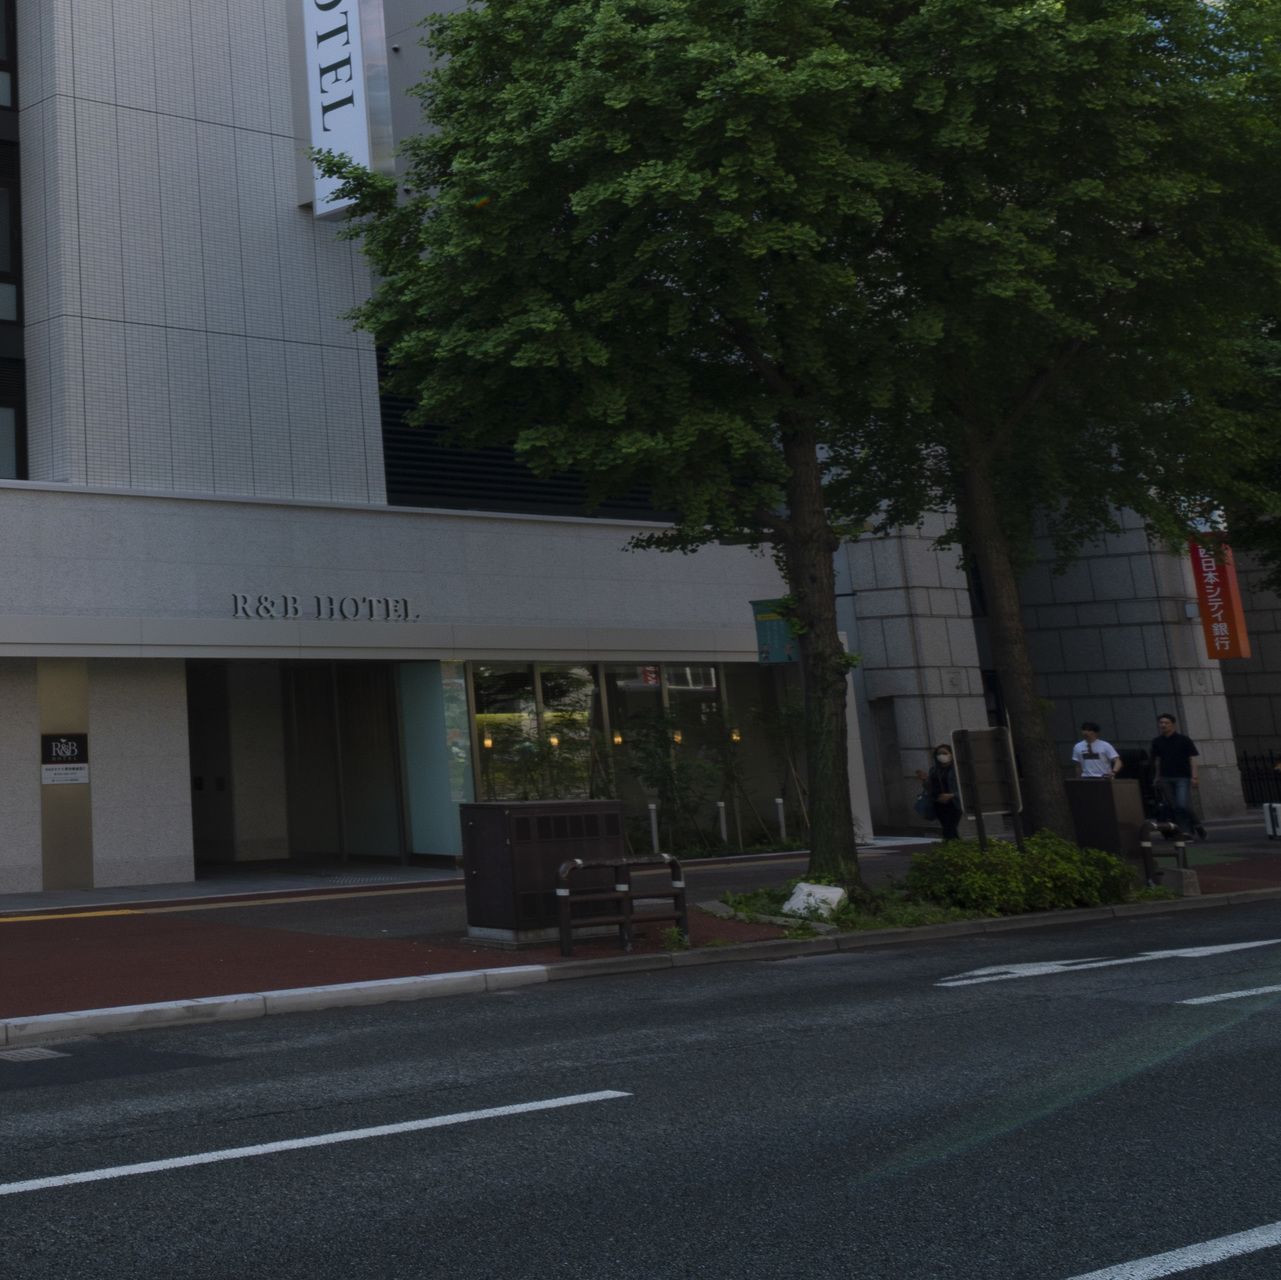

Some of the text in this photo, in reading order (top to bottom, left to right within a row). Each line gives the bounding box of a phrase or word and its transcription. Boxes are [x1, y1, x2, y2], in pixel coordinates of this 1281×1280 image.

[232, 593, 420, 622] R&B HOTEL
[51, 741, 78, 757] R&B
